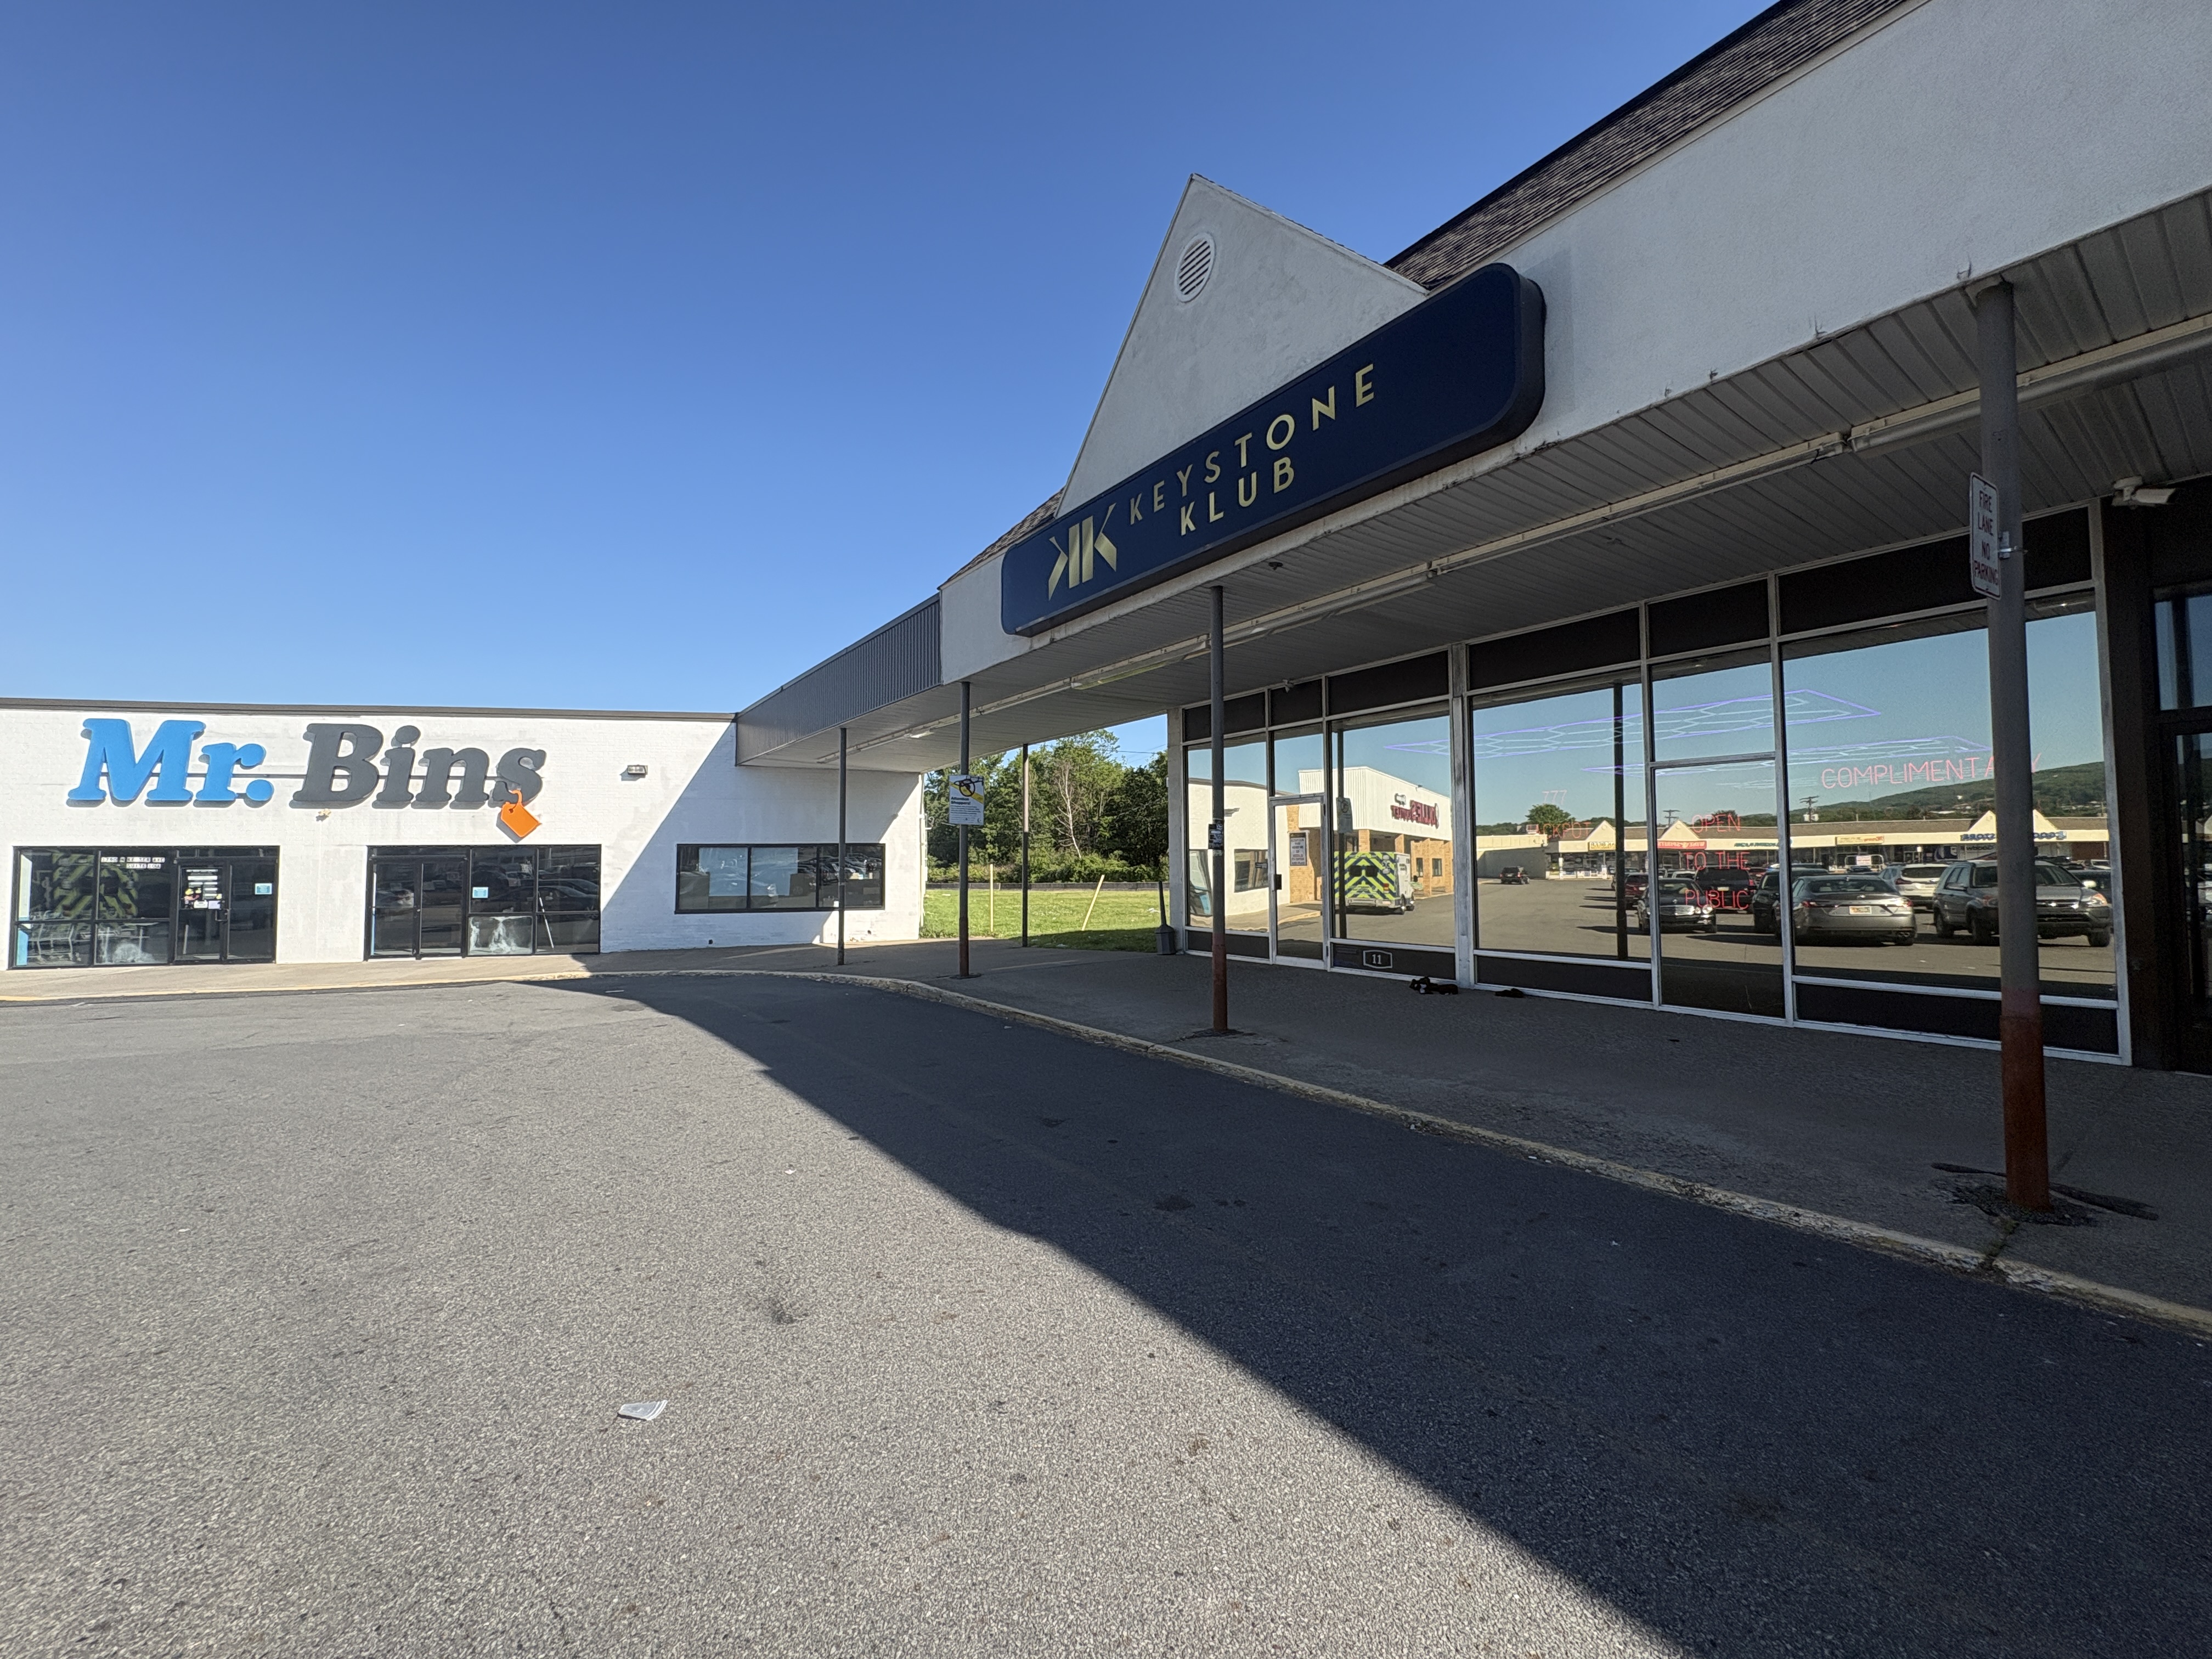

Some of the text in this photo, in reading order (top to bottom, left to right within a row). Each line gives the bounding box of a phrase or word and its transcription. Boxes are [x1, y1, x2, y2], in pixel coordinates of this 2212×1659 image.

[1129, 363, 1375, 524] KEYSTONE
[1180, 455, 1296, 537] KLUB
[1979, 490, 1993, 514] FIRE
[1977, 511, 1994, 537] LANE
[1982, 540, 1990, 560] NO
[1974, 560, 1999, 585] PARKING
[67, 718, 546, 806] Mr. Bins
[1542, 789, 1567, 805] 777
[1691, 813, 1741, 833] OPEN
[1683, 851, 1751, 871] TO THE
[1685, 889, 1750, 910] PUBLIC
[1372, 954, 1382, 964] 11
